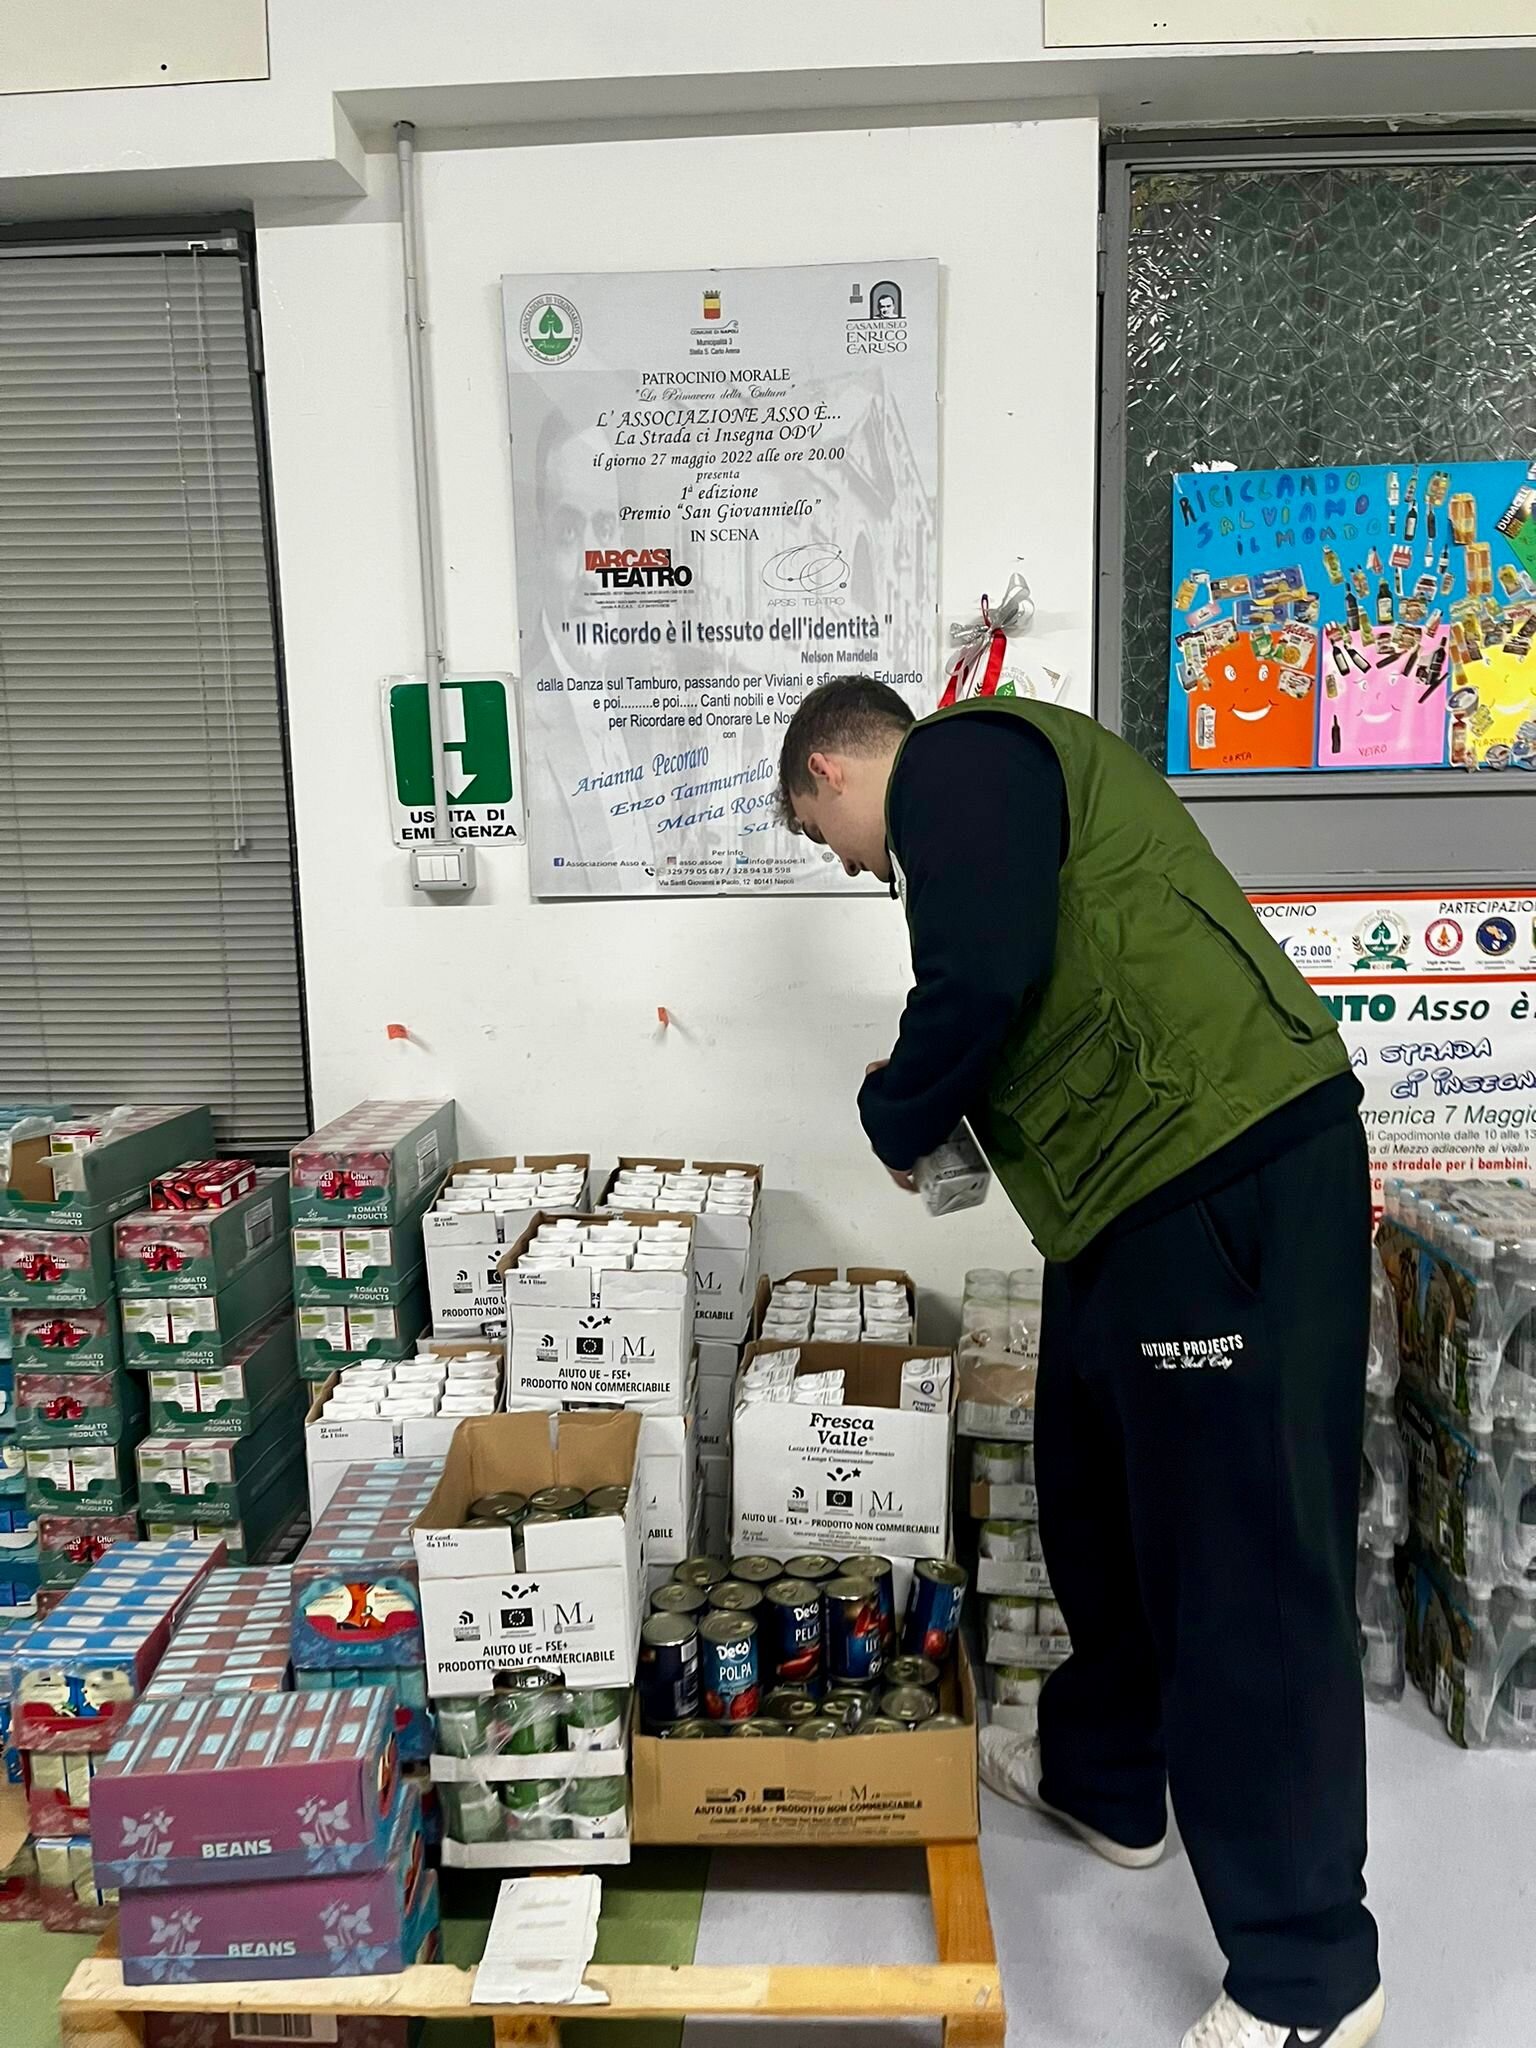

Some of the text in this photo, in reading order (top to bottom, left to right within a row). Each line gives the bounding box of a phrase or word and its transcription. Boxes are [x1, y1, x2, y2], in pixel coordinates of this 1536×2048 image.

[846, 330, 907, 344] ENRICO
[846, 342, 907, 356] CARUSO
[642, 368, 791, 386] PATROCINIO MORALE
[720, 386, 742, 400] della
[617, 407, 759, 429] ASSOCIAZIONE
[762, 405, 810, 424] ASSO
[614, 422, 823, 447] La Strada ci Insegna ODV
[593, 447, 845, 472] il giorno 27 maggio 2022 alle ore 20.00
[696, 470, 740, 484] presenta
[698, 483, 759, 500] edizione
[618, 505, 672, 521] Premio
[690, 528, 760, 543] IN SCENA
[595, 565, 693, 589] TEATRO
[803, 596, 846, 607] TEATRO
[576, 613, 879, 645] Il Ricordo è il tessuto dell'identità
[801, 649, 879, 664] Nelson Mandela
[537, 676, 563, 692] dalla
[566, 677, 604, 692] Danza
[606, 676, 624, 691] sul
[626, 675, 682, 692] Tamburo,
[684, 676, 741, 693] passando
[742, 677, 762, 692] per
[764, 673, 804, 688] Viviani
[806, 676, 814, 686] e
[873, 669, 923, 684] Eduardo
[593, 699, 600, 709] e
[700, 692, 732, 708] Canti
[733, 691, 765, 707] nobili
[766, 696, 774, 706] e
[777, 690, 803, 706] Voci
[608, 711, 770, 730] per Ricordare ed Onorare Le
[723, 730, 737, 739] con
[1222, 751, 1253, 764] CARTA
[571, 745, 710, 797] Arianna Pecoraro
[610, 757, 774, 817] Enzo Tammurriello
[410, 809, 505, 824] USITA DI
[656, 805, 724, 834] Maria
[401, 825, 517, 840] EMGENZA
[566, 859, 640, 868] Associazione Asso
[1256, 900, 1536, 918] ROCINIO PARTECIPAZIO
[1293, 945, 1332, 957] 25 000
[1320, 994, 1396, 1023] NTO
[1408, 994, 1491, 1022] Asso
[1380, 1037, 1493, 1066] STRADA
[1359, 1105, 1436, 1125] menica
[1445, 1105, 1458, 1124] 7
[1377, 1130, 1450, 1142] Capodimonte
[1454, 1129, 1480, 1140] dalle
[1484, 1129, 1497, 1140] 10
[1500, 1129, 1520, 1140] alle
[1379, 1144, 1390, 1155] di
[1392, 1145, 1429, 1155] Mezzo
[1431, 1144, 1485, 1155] adiacente
[1392, 1157, 1442, 1171] stradale
[1445, 1161, 1466, 1173] per
[1470, 1157, 1474, 1170] i
[1478, 1156, 1533, 1170] bambini.
[347, 1212, 388, 1221] PRODUCTS
[354, 1205, 388, 1214] TOMATO
[348, 1293, 389, 1301] PRODUCTS
[355, 1286, 389, 1294] TOMATO
[442, 1307, 505, 1318] PRODOTTO NON
[695, 1309, 734, 1321] ERCIABILE
[1140, 1333, 1244, 1357] FUTURE PROJECTS
[558, 1368, 632, 1380] AIUTO UE FSE+
[520, 1377, 671, 1393] PRODOTTO NON COMMERCIABILE
[809, 1412, 875, 1431] Fresca
[816, 1430, 868, 1447] Valle
[741, 1512, 940, 1534] AIUTO PRODOTTO NON COMMERCIABILE
[795, 1622, 820, 1642] PELA
[482, 1640, 568, 1657] AIUTO UE FSE+
[438, 1650, 615, 1673] PRODOTTO NON COMMERCIABILE
[719, 1662, 752, 1682] POLPA
[202, 1839, 273, 1859] BEANS
[228, 1940, 297, 1958] BEANS
